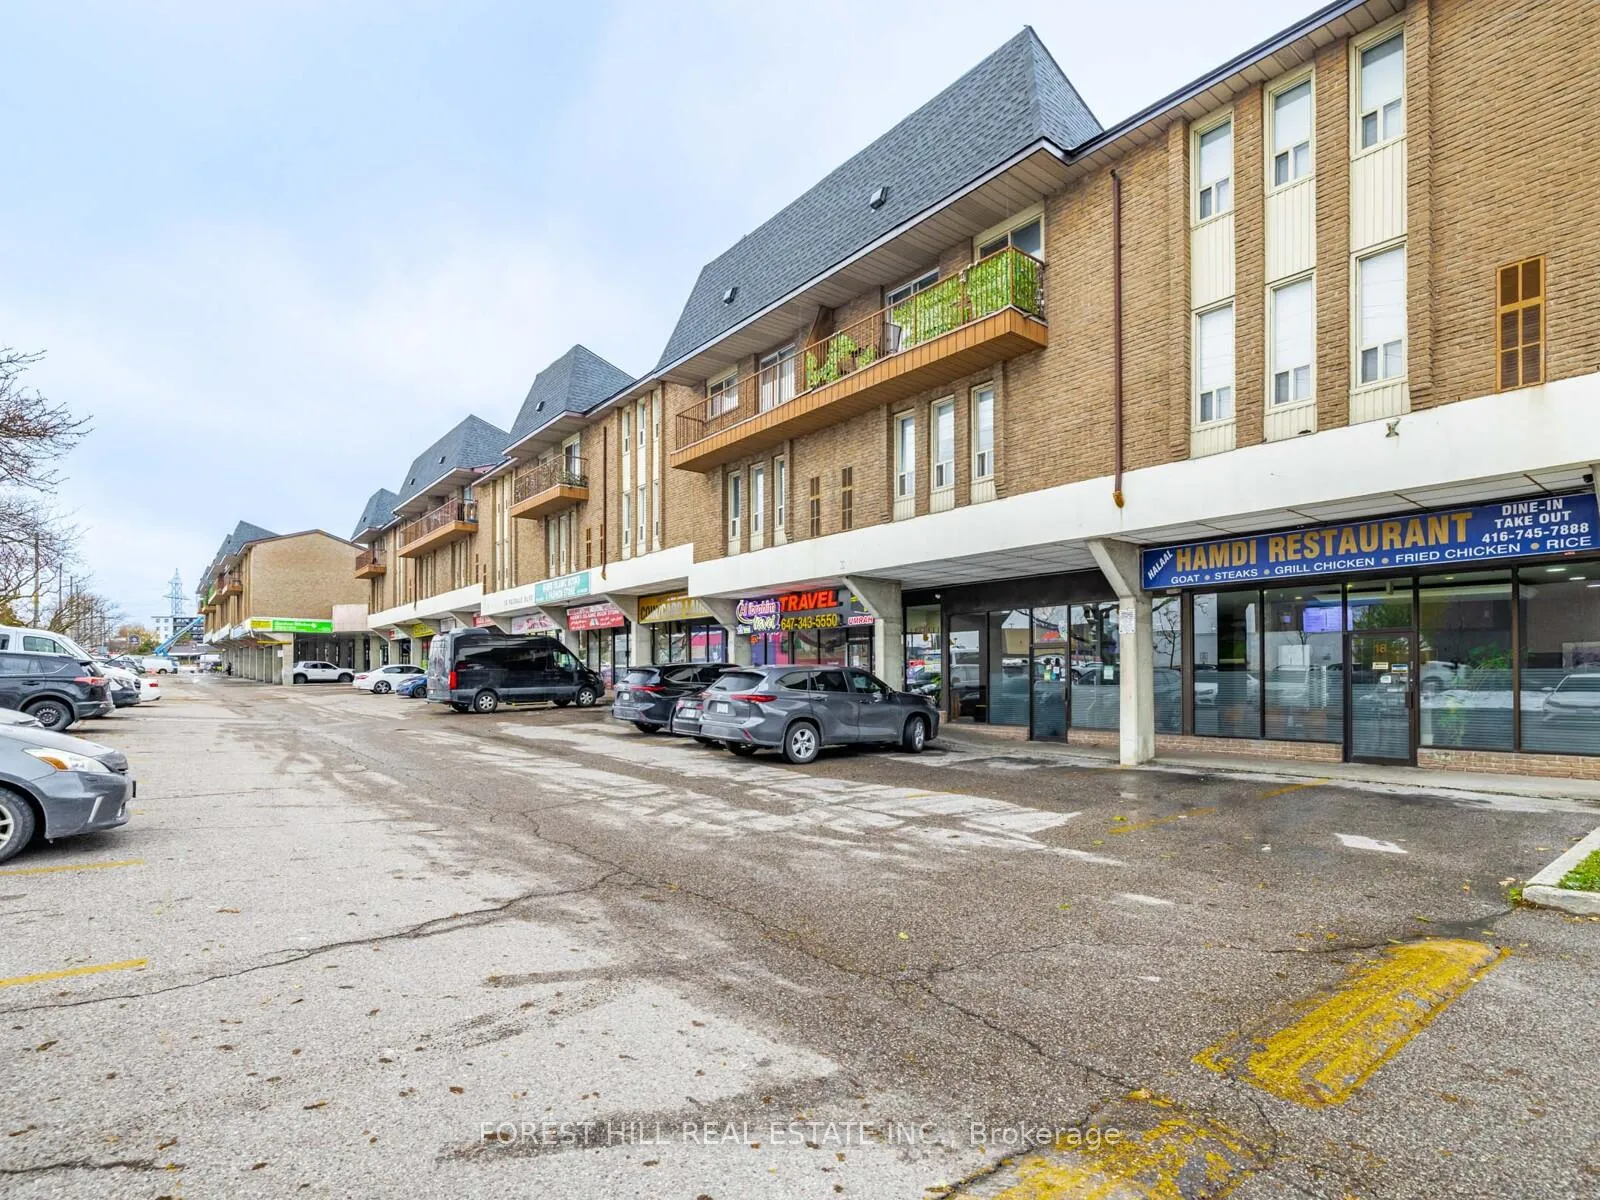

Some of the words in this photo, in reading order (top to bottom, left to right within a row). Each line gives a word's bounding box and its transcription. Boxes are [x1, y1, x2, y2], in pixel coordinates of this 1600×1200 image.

[1502, 498, 1563, 516] DINE-IN
[1494, 515, 1533, 529] TAKE
[1539, 510, 1572, 524] OUT
[1175, 539, 1257, 573] HAMDI
[1268, 511, 1473, 563] RESTAURANT
[1481, 522, 1589, 544] 416-745-7888
[1147, 549, 1174, 580] HALAAL
[1170, 574, 1200, 585] GOAT
[1214, 568, 1258, 580] STEAKS
[1274, 564, 1310, 575] GRILL
[1313, 557, 1375, 572] CHICKEN
[1395, 550, 1440, 564] FRIED
[1444, 542, 1521, 562] CHICKEN
[1546, 535, 1592, 550] RICE
[779, 589, 838, 612] TRAVEL
[780, 613, 838, 631] 647-343-5550
